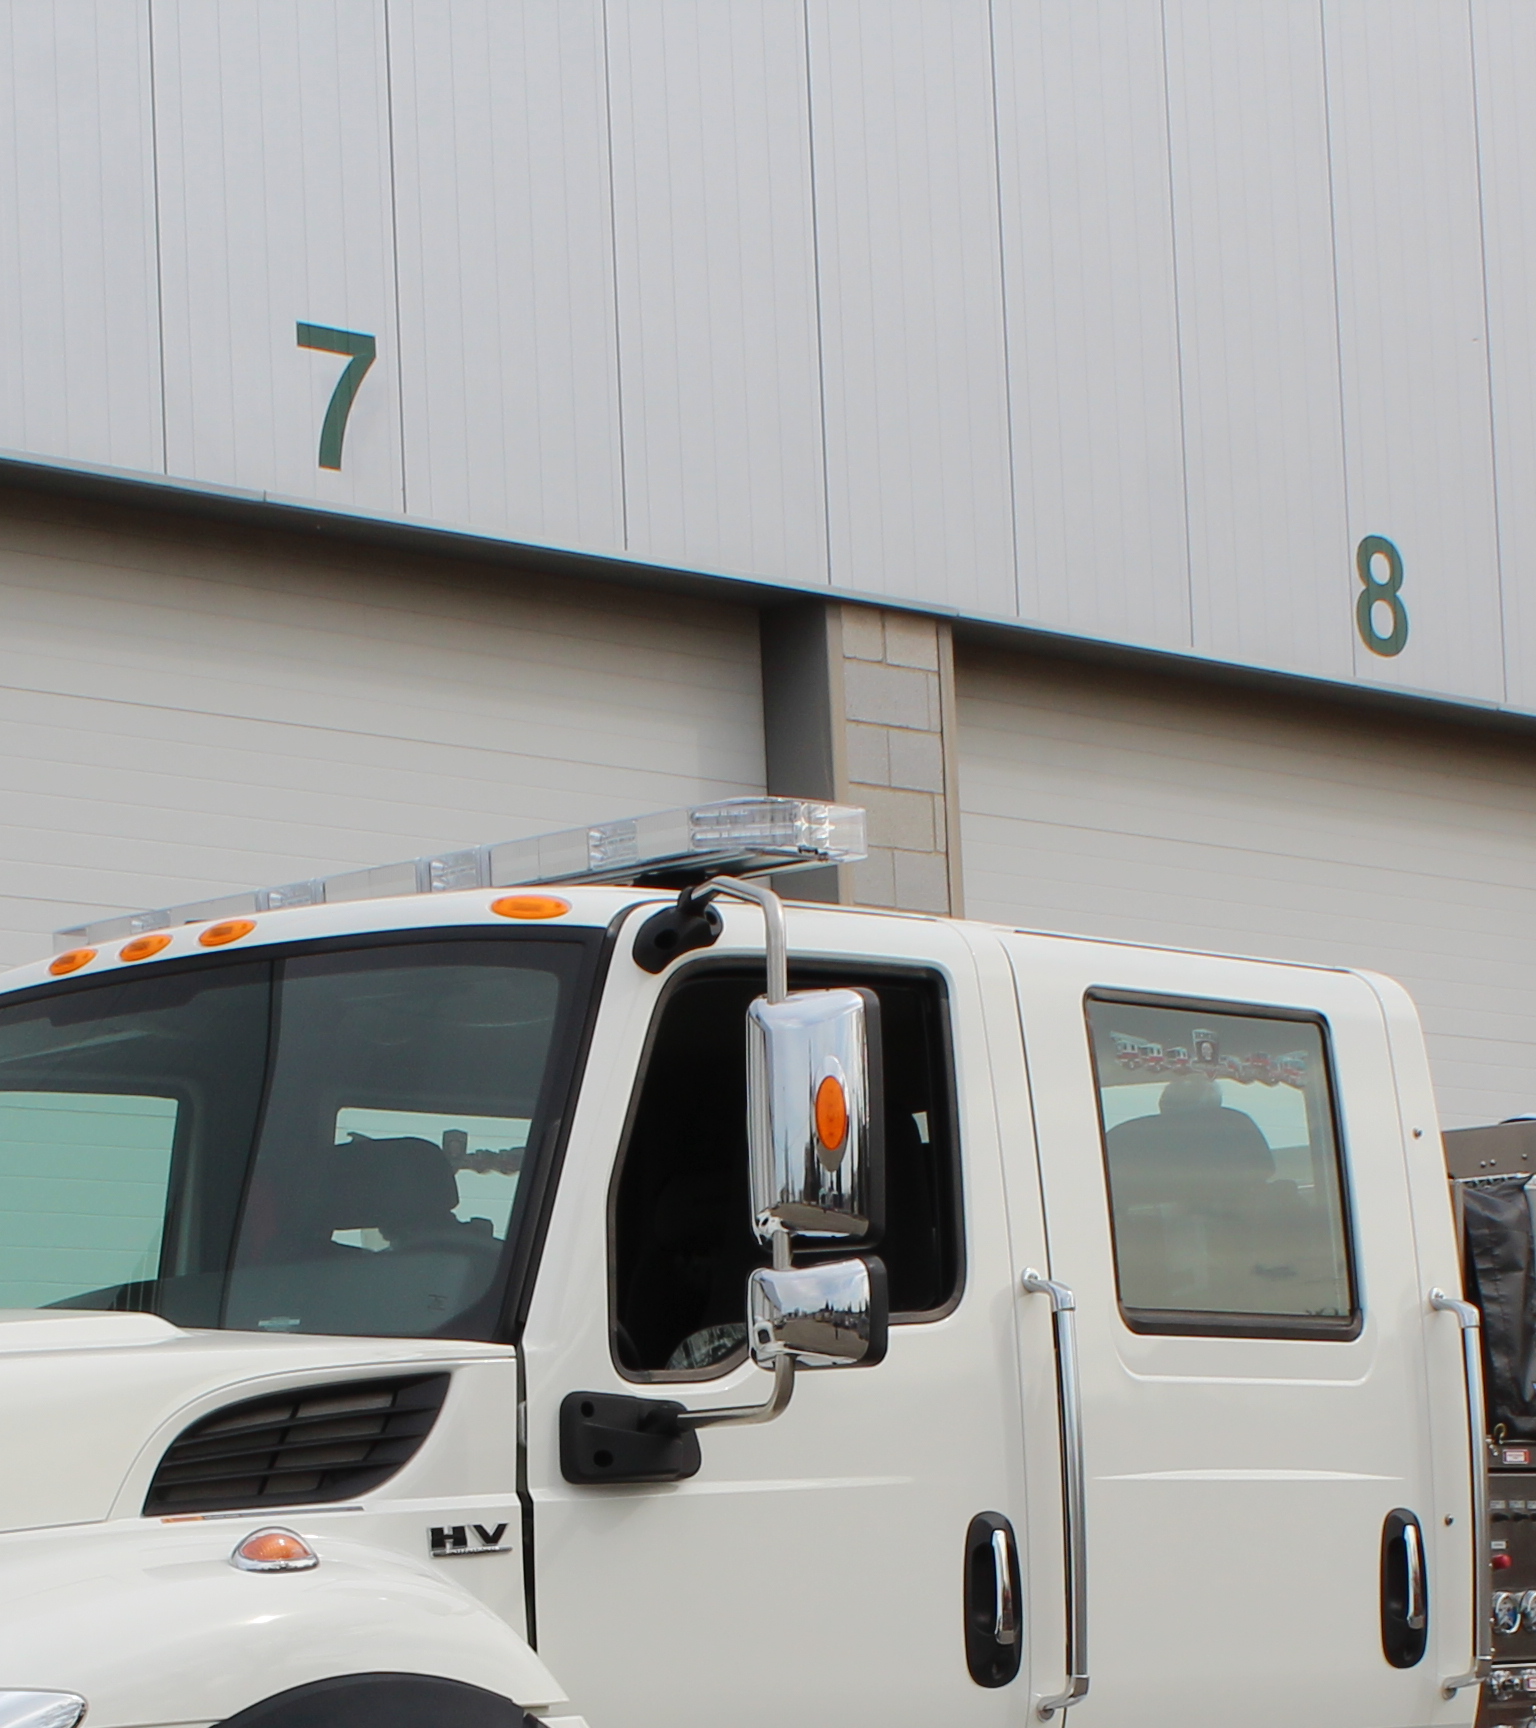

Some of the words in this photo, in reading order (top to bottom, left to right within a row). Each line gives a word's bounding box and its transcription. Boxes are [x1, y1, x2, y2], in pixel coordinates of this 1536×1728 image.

[296, 321, 377, 471] 7
[1355, 534, 1409, 658] 8
[429, 1522, 509, 1548] HV
